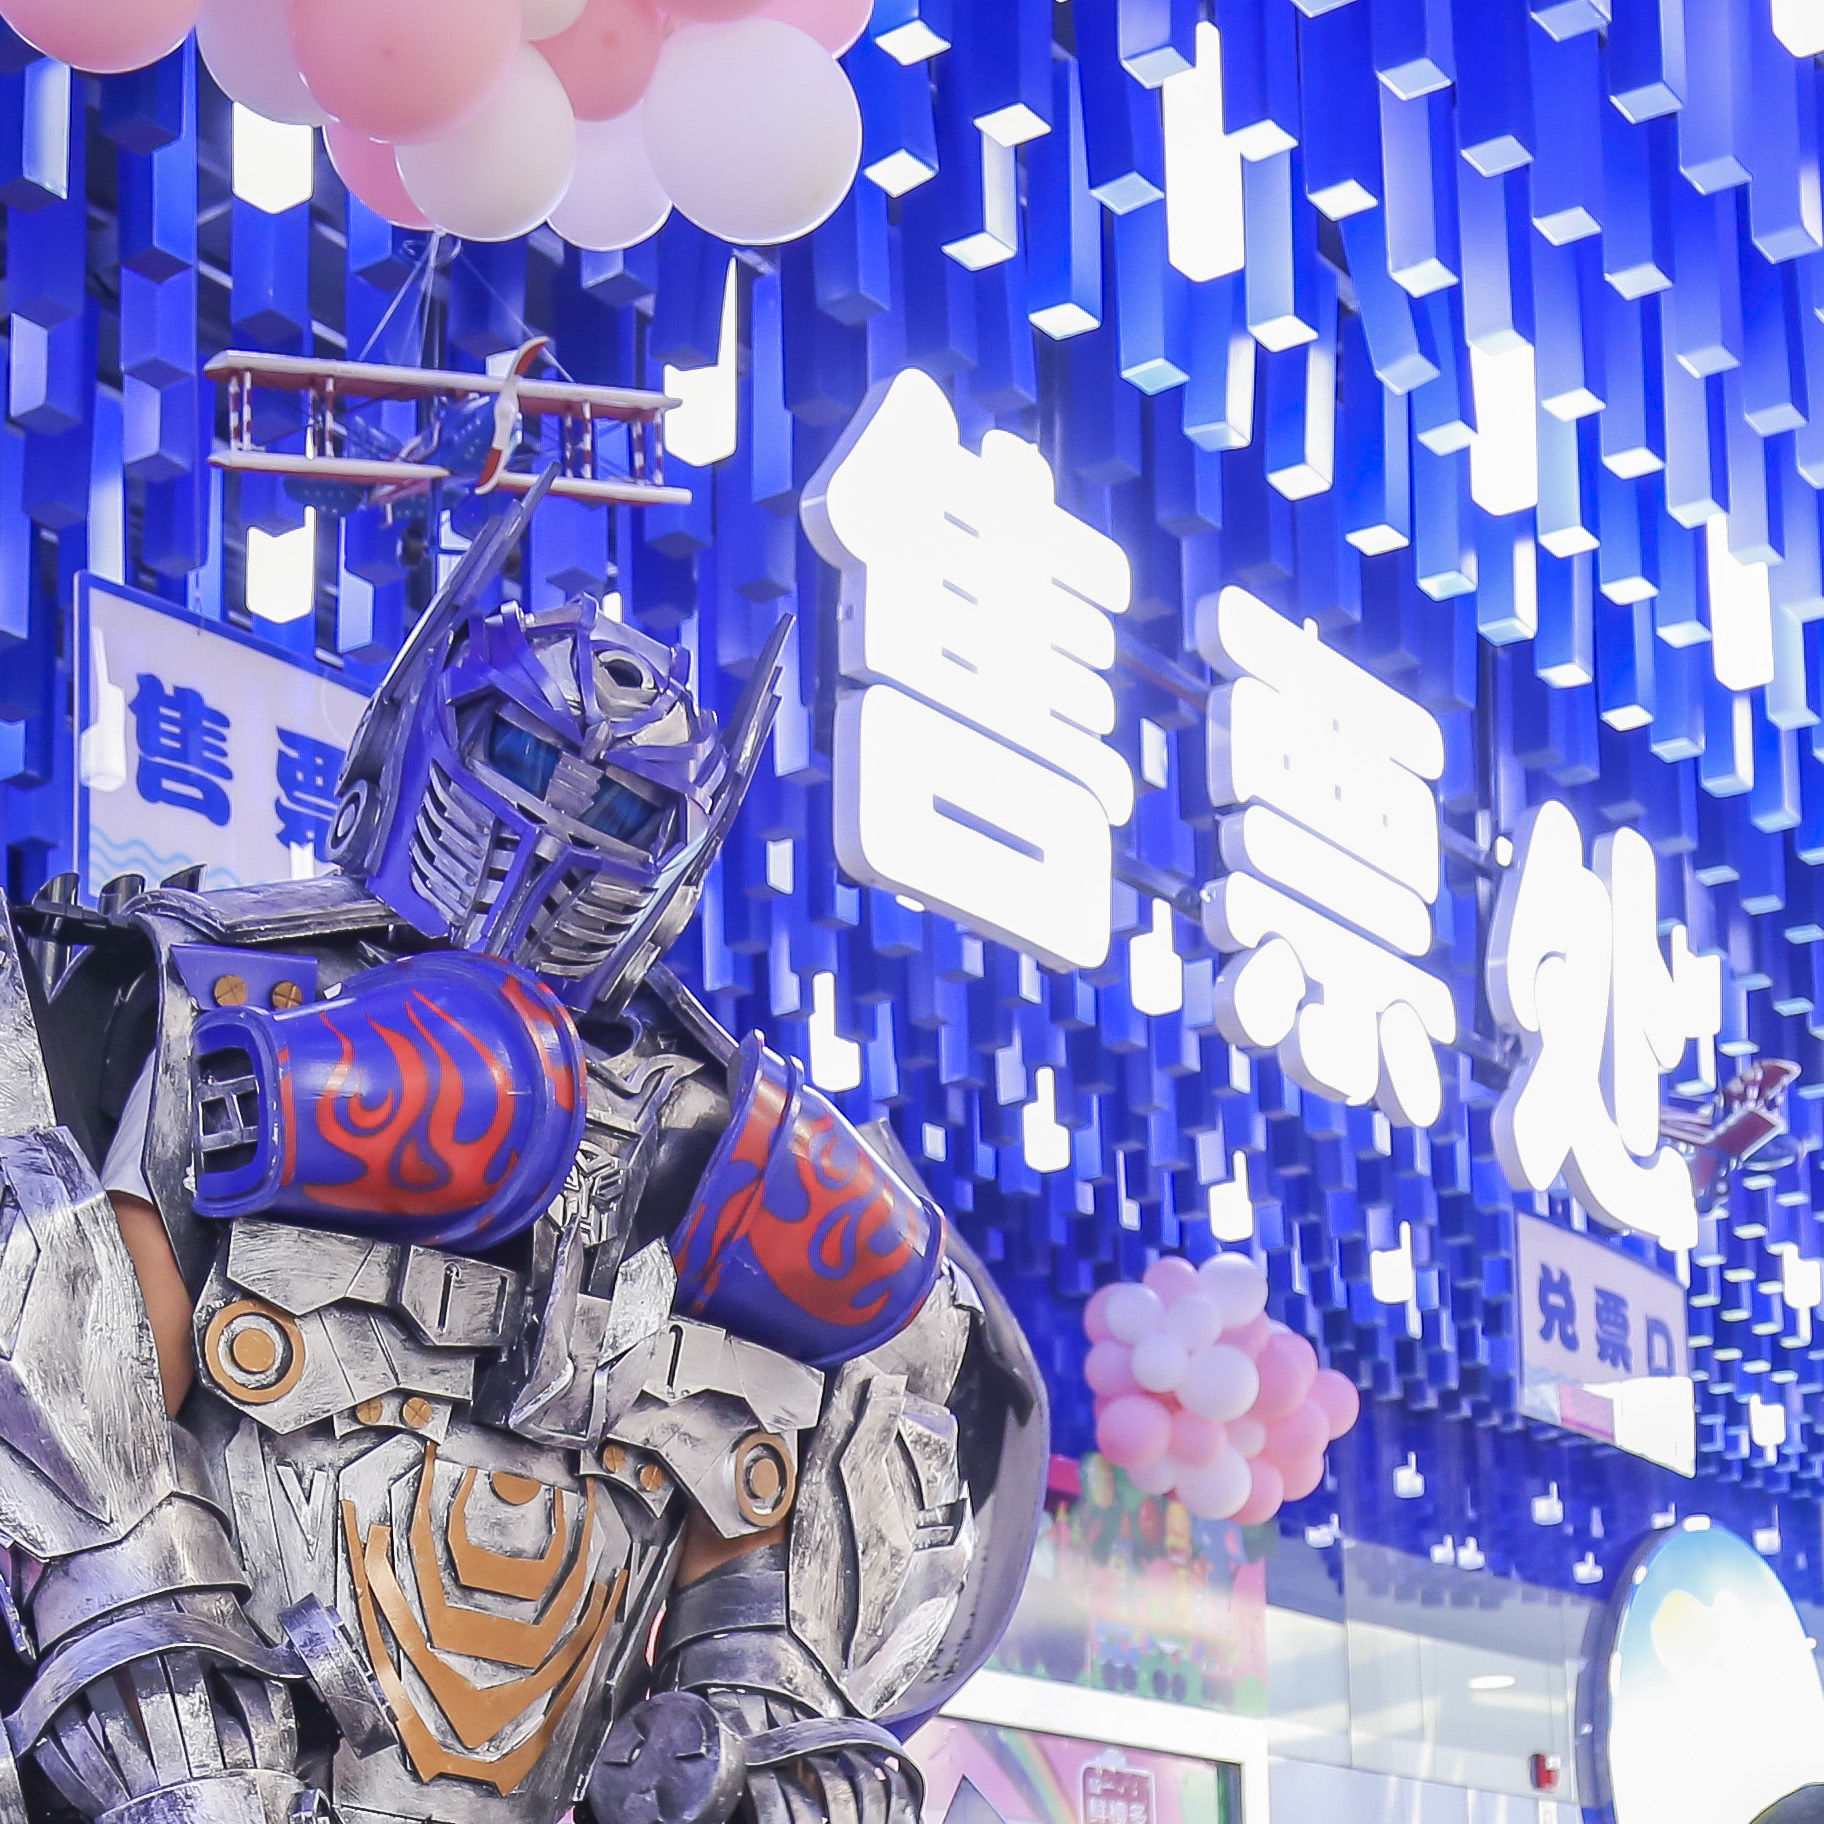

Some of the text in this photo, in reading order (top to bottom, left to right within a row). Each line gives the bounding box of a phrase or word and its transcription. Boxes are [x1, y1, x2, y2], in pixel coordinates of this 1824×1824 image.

[802, 367, 1716, 1250] 售票处
[1539, 1262, 1675, 1376] 兑票口
